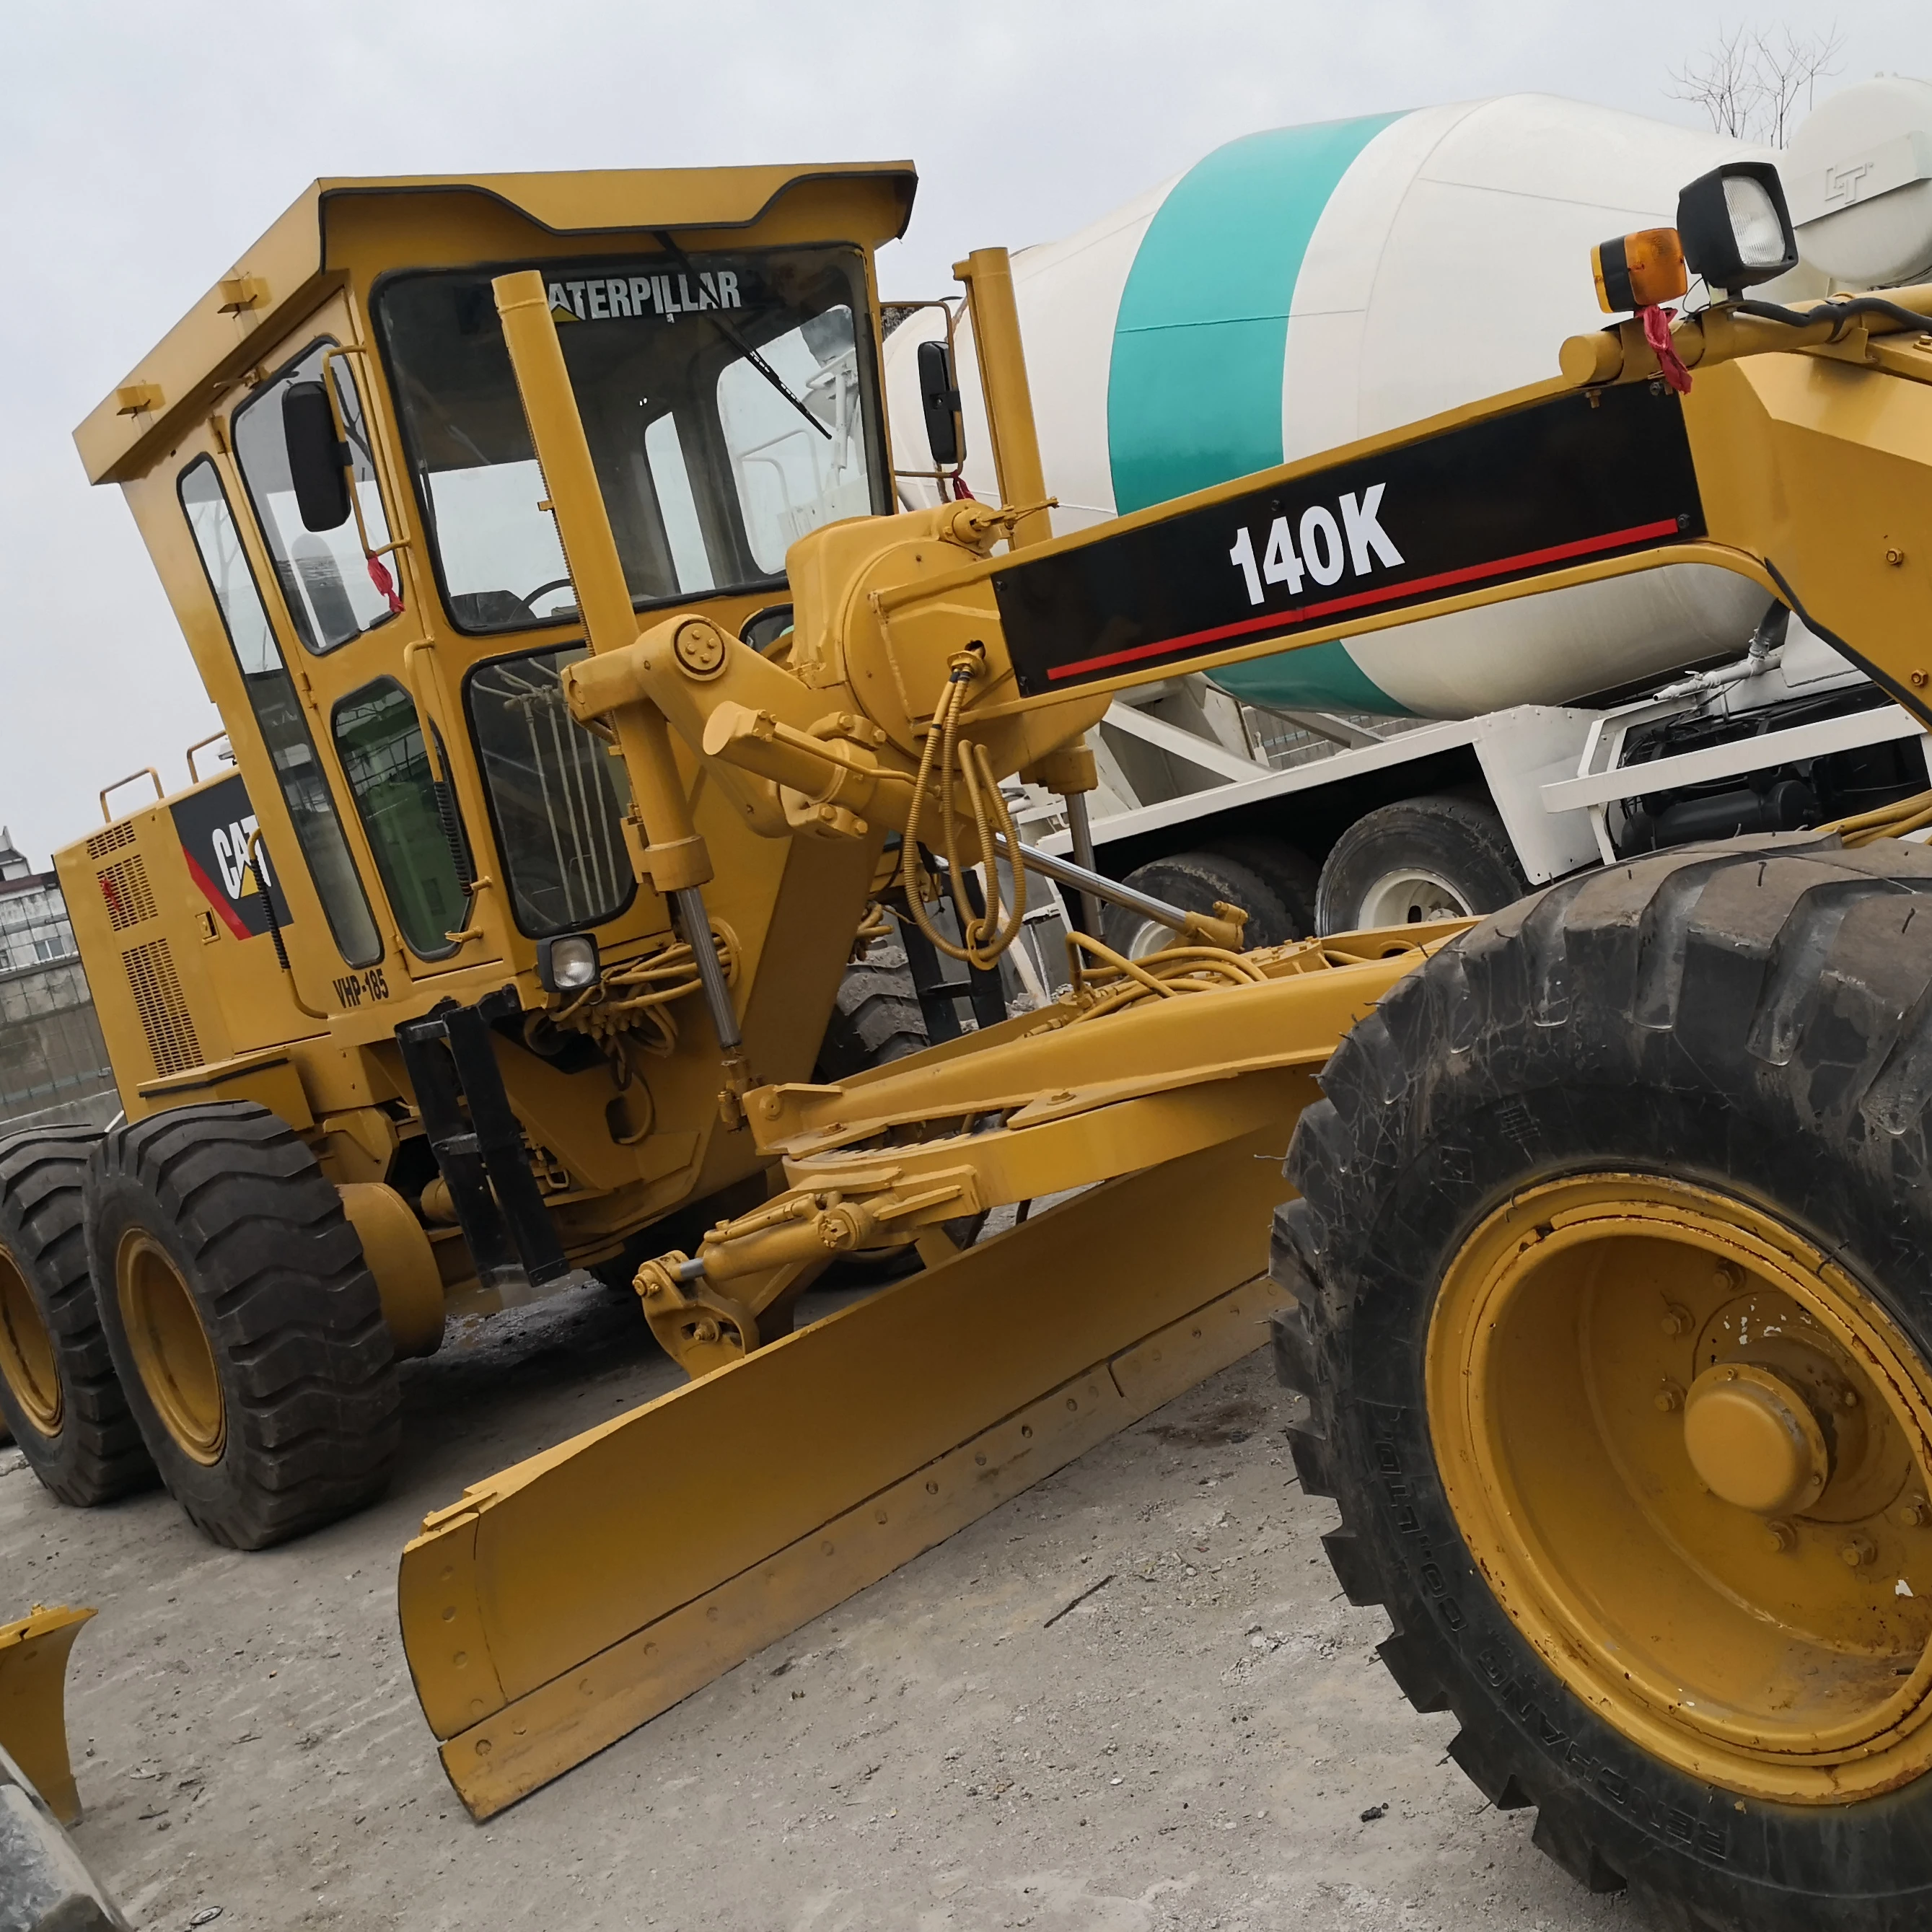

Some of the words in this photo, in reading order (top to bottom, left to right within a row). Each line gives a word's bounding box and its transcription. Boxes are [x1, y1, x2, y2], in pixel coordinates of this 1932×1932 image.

[548, 271, 742, 321] ATERPILLAR
[1229, 482, 1406, 605] 140K
[212, 814, 272, 900] CAT
[333, 968, 389, 1009] VHP-185
